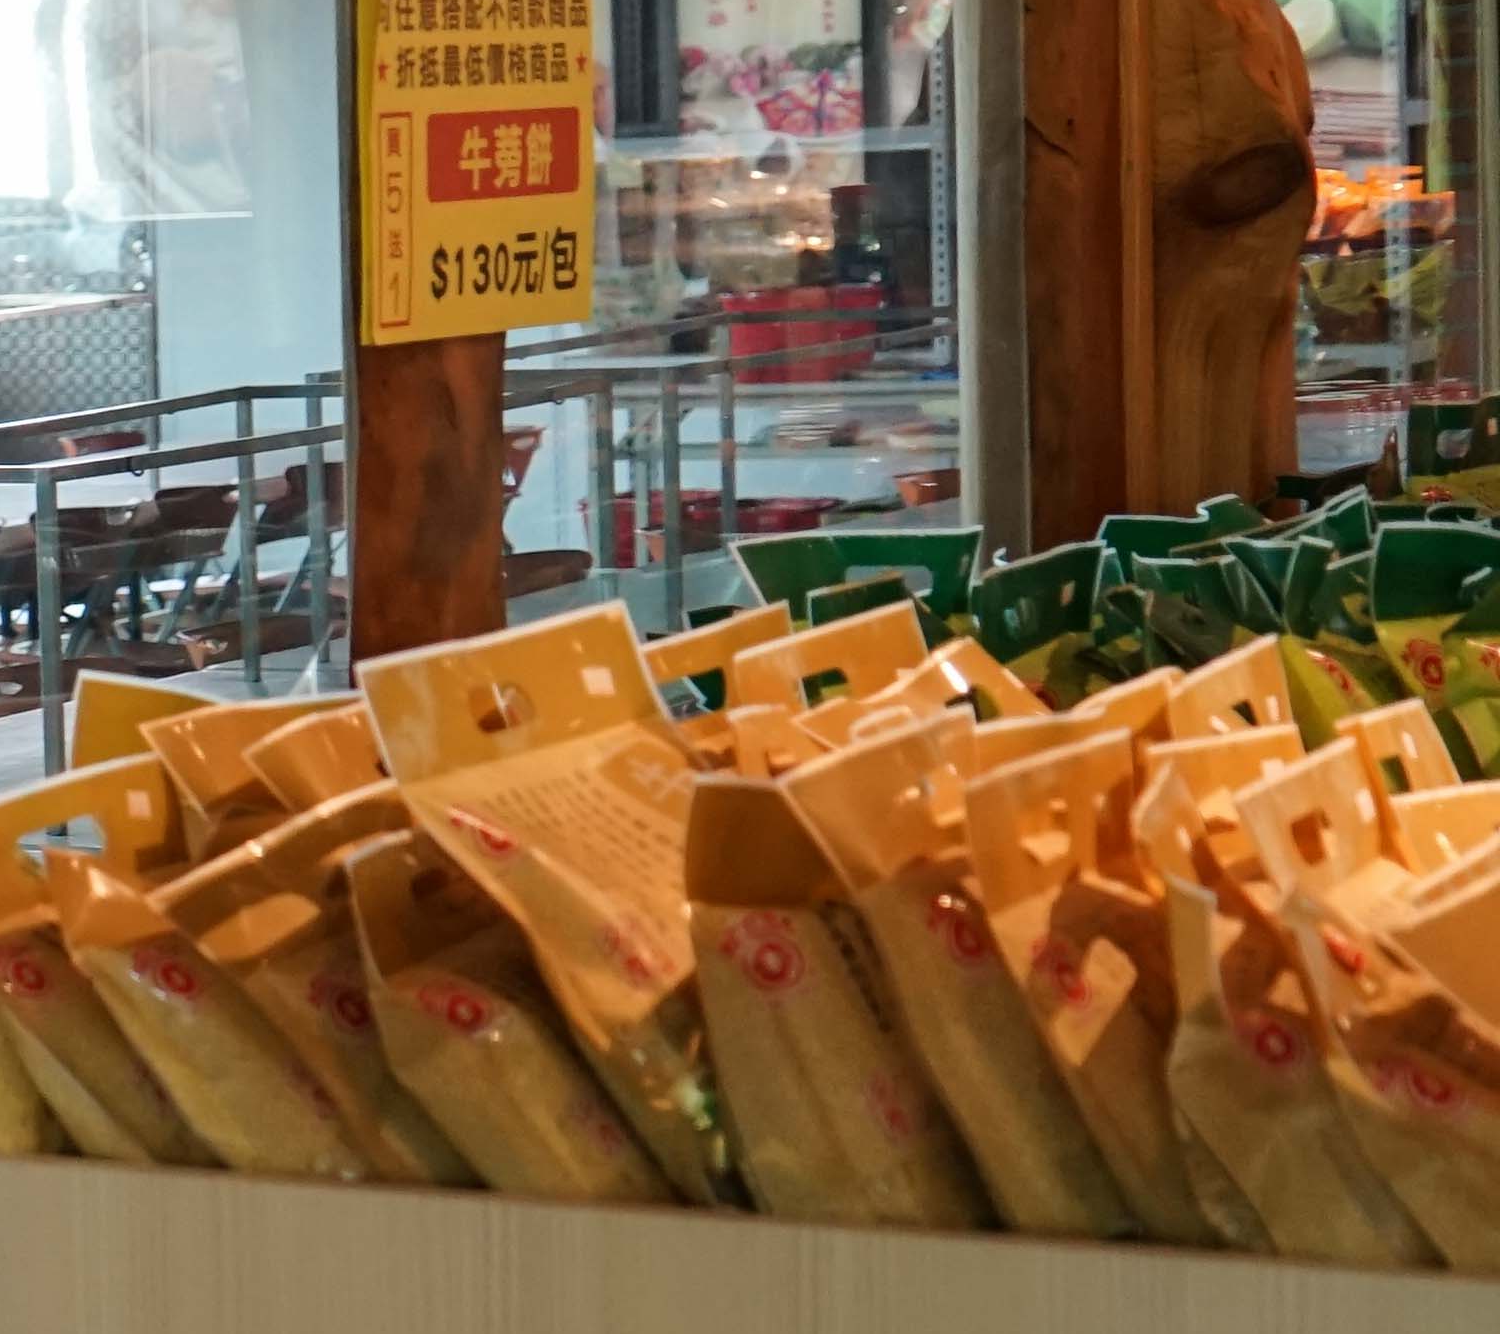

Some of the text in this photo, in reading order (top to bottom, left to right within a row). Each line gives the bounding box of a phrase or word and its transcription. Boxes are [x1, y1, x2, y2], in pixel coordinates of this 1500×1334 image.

[458, 122, 554, 192] 牛蒡餅
[430, 226, 579, 304] $130元/包
